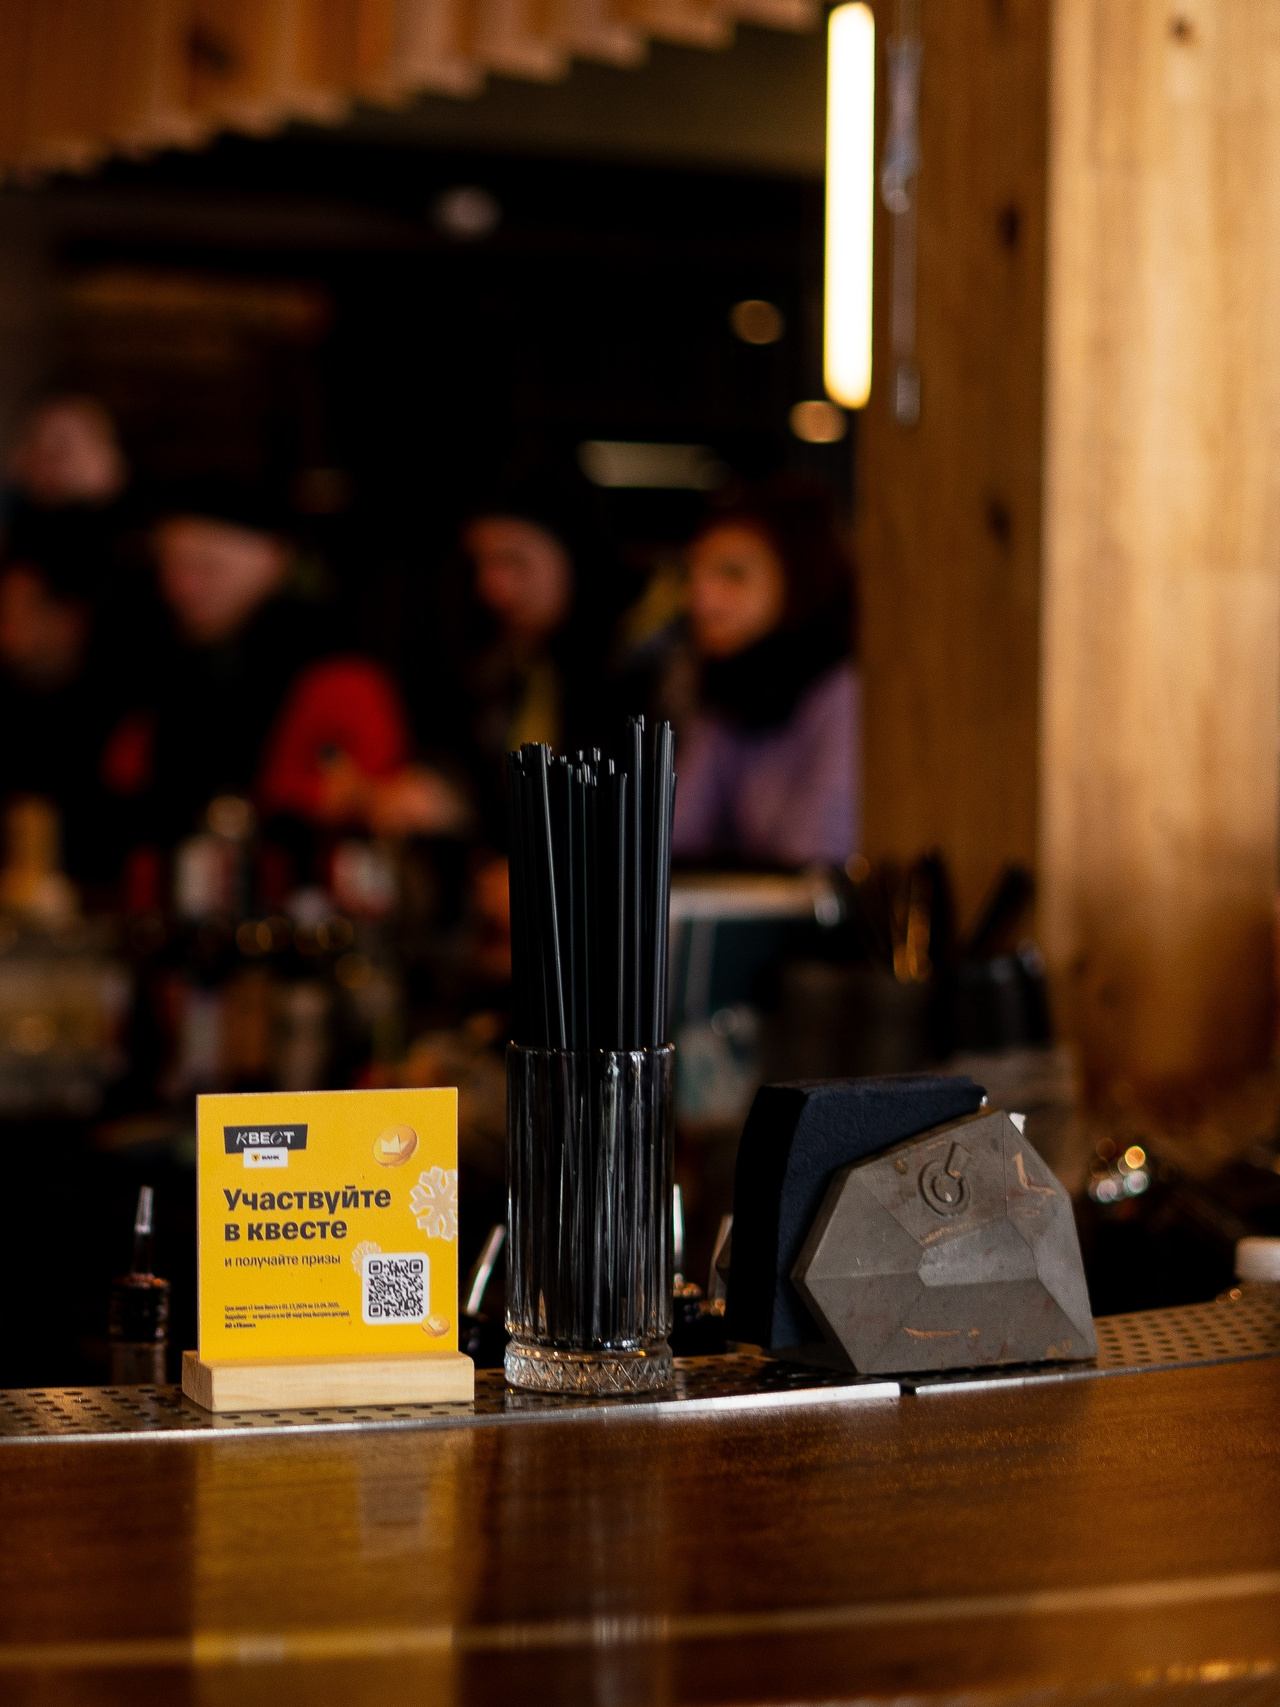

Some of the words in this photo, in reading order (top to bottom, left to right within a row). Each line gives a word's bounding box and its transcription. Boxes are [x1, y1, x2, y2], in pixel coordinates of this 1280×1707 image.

[236, 1131, 295, 1145] КВЕСТ
[223, 1185, 391, 1214] Участвуйте
[224, 1223, 240, 1241] в
[247, 1220, 347, 1240] квесте
[224, 1257, 232, 1267] и
[235, 1254, 299, 1269] получайте
[301, 1254, 341, 1267] призы
